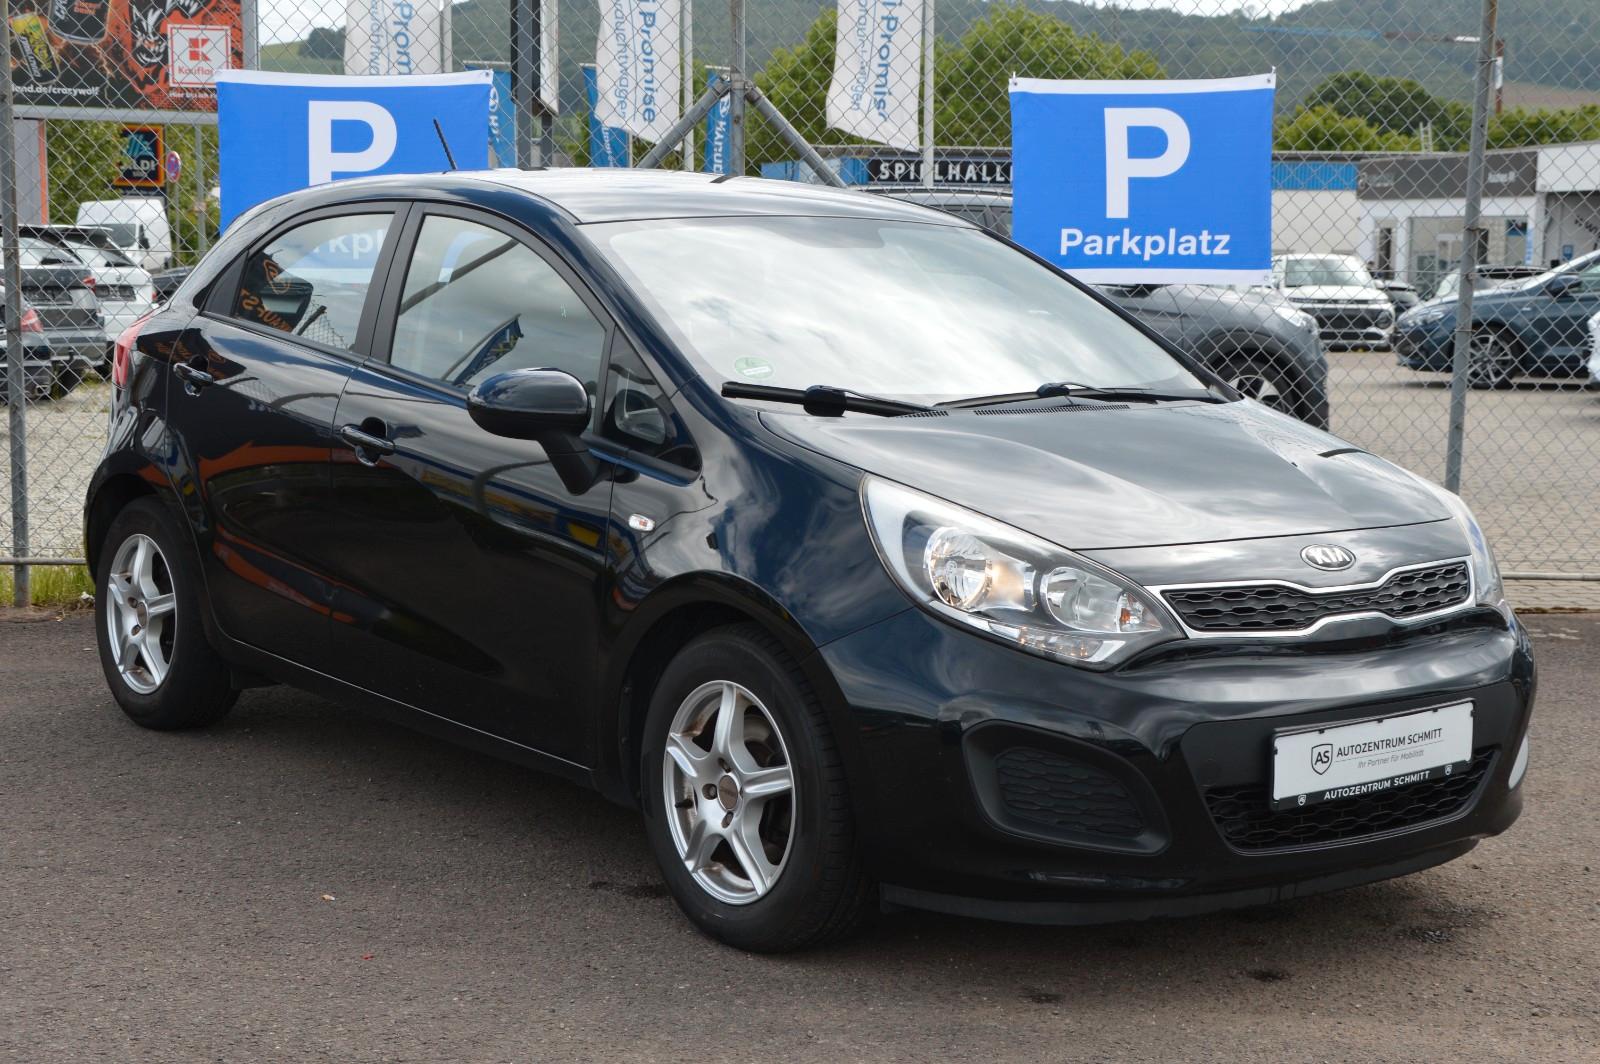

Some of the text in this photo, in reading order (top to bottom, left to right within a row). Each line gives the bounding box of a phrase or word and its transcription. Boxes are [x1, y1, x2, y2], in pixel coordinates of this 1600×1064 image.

[639, 11, 658, 123] Promise
[308, 100, 398, 187] P
[879, 162, 1012, 182] SPILHALL
[1104, 107, 1191, 219] P
[1060, 227, 1231, 261] Parkplatz
[1314, 750, 1330, 766] AS
[1336, 728, 1443, 758] AUTOZENTRUM SCHMITT
[1367, 755, 1390, 768] Partner
[1323, 779, 1391, 801] AUTOZENTRUM
[1393, 770, 1431, 787] SCHMITT
